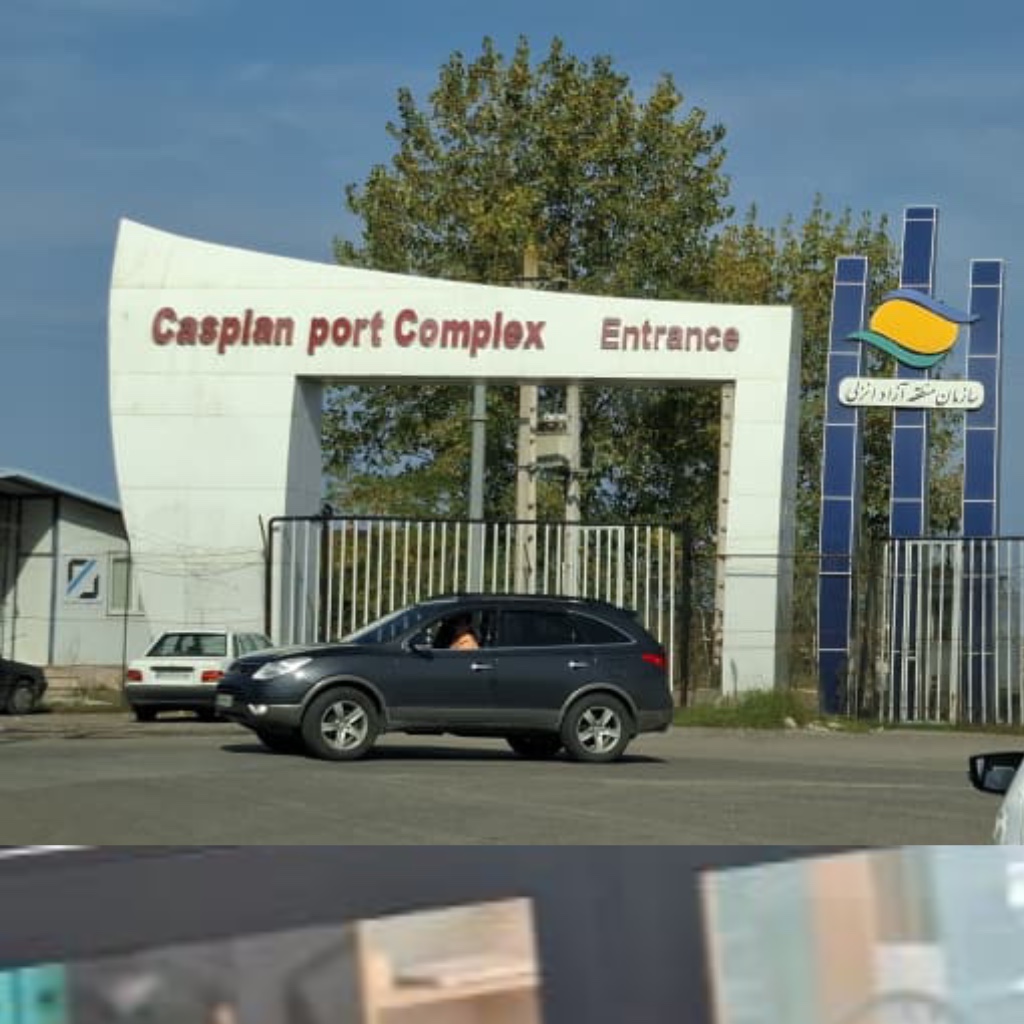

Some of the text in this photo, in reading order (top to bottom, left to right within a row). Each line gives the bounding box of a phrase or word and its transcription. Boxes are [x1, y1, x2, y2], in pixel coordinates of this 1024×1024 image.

[151, 306, 547, 358] Caspian port Complex
[600, 317, 741, 352] Entrance
[935, 386, 979, 407] سازمان
